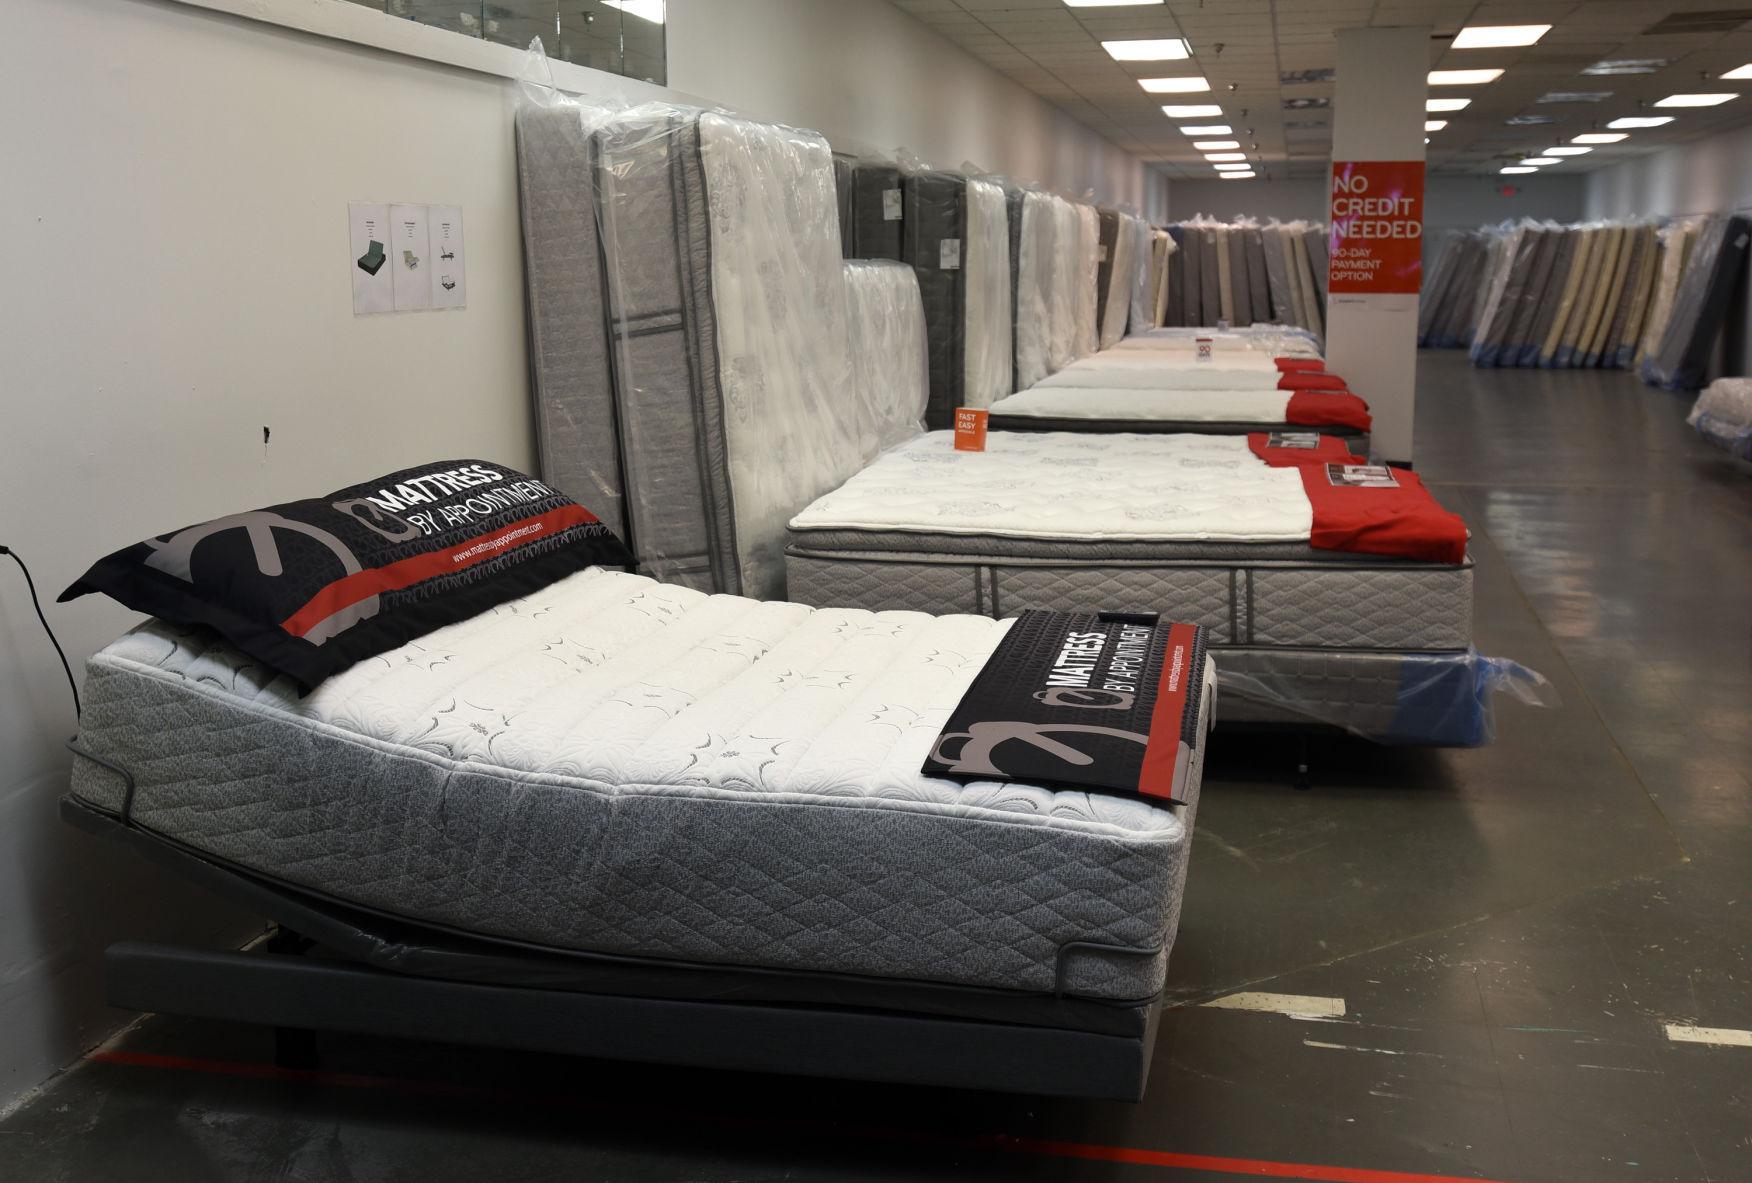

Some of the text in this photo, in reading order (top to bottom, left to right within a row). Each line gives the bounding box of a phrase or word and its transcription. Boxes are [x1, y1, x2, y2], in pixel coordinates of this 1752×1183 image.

[1333, 175, 1369, 194] NO
[1333, 198, 1415, 216] CREDIT
[1331, 220, 1423, 239] NEEDED
[1331, 259, 1382, 270] PAYMENT
[1331, 271, 1374, 281] OPTION
[958, 421, 976, 430] EASY
[959, 413, 976, 421] FAST
[366, 464, 503, 513] MATTRESS
[407, 479, 554, 535] BY APPOINTMENT
[1045, 631, 1107, 688] MATTRESS
[1103, 623, 1152, 692] BY APPOINTMENT
